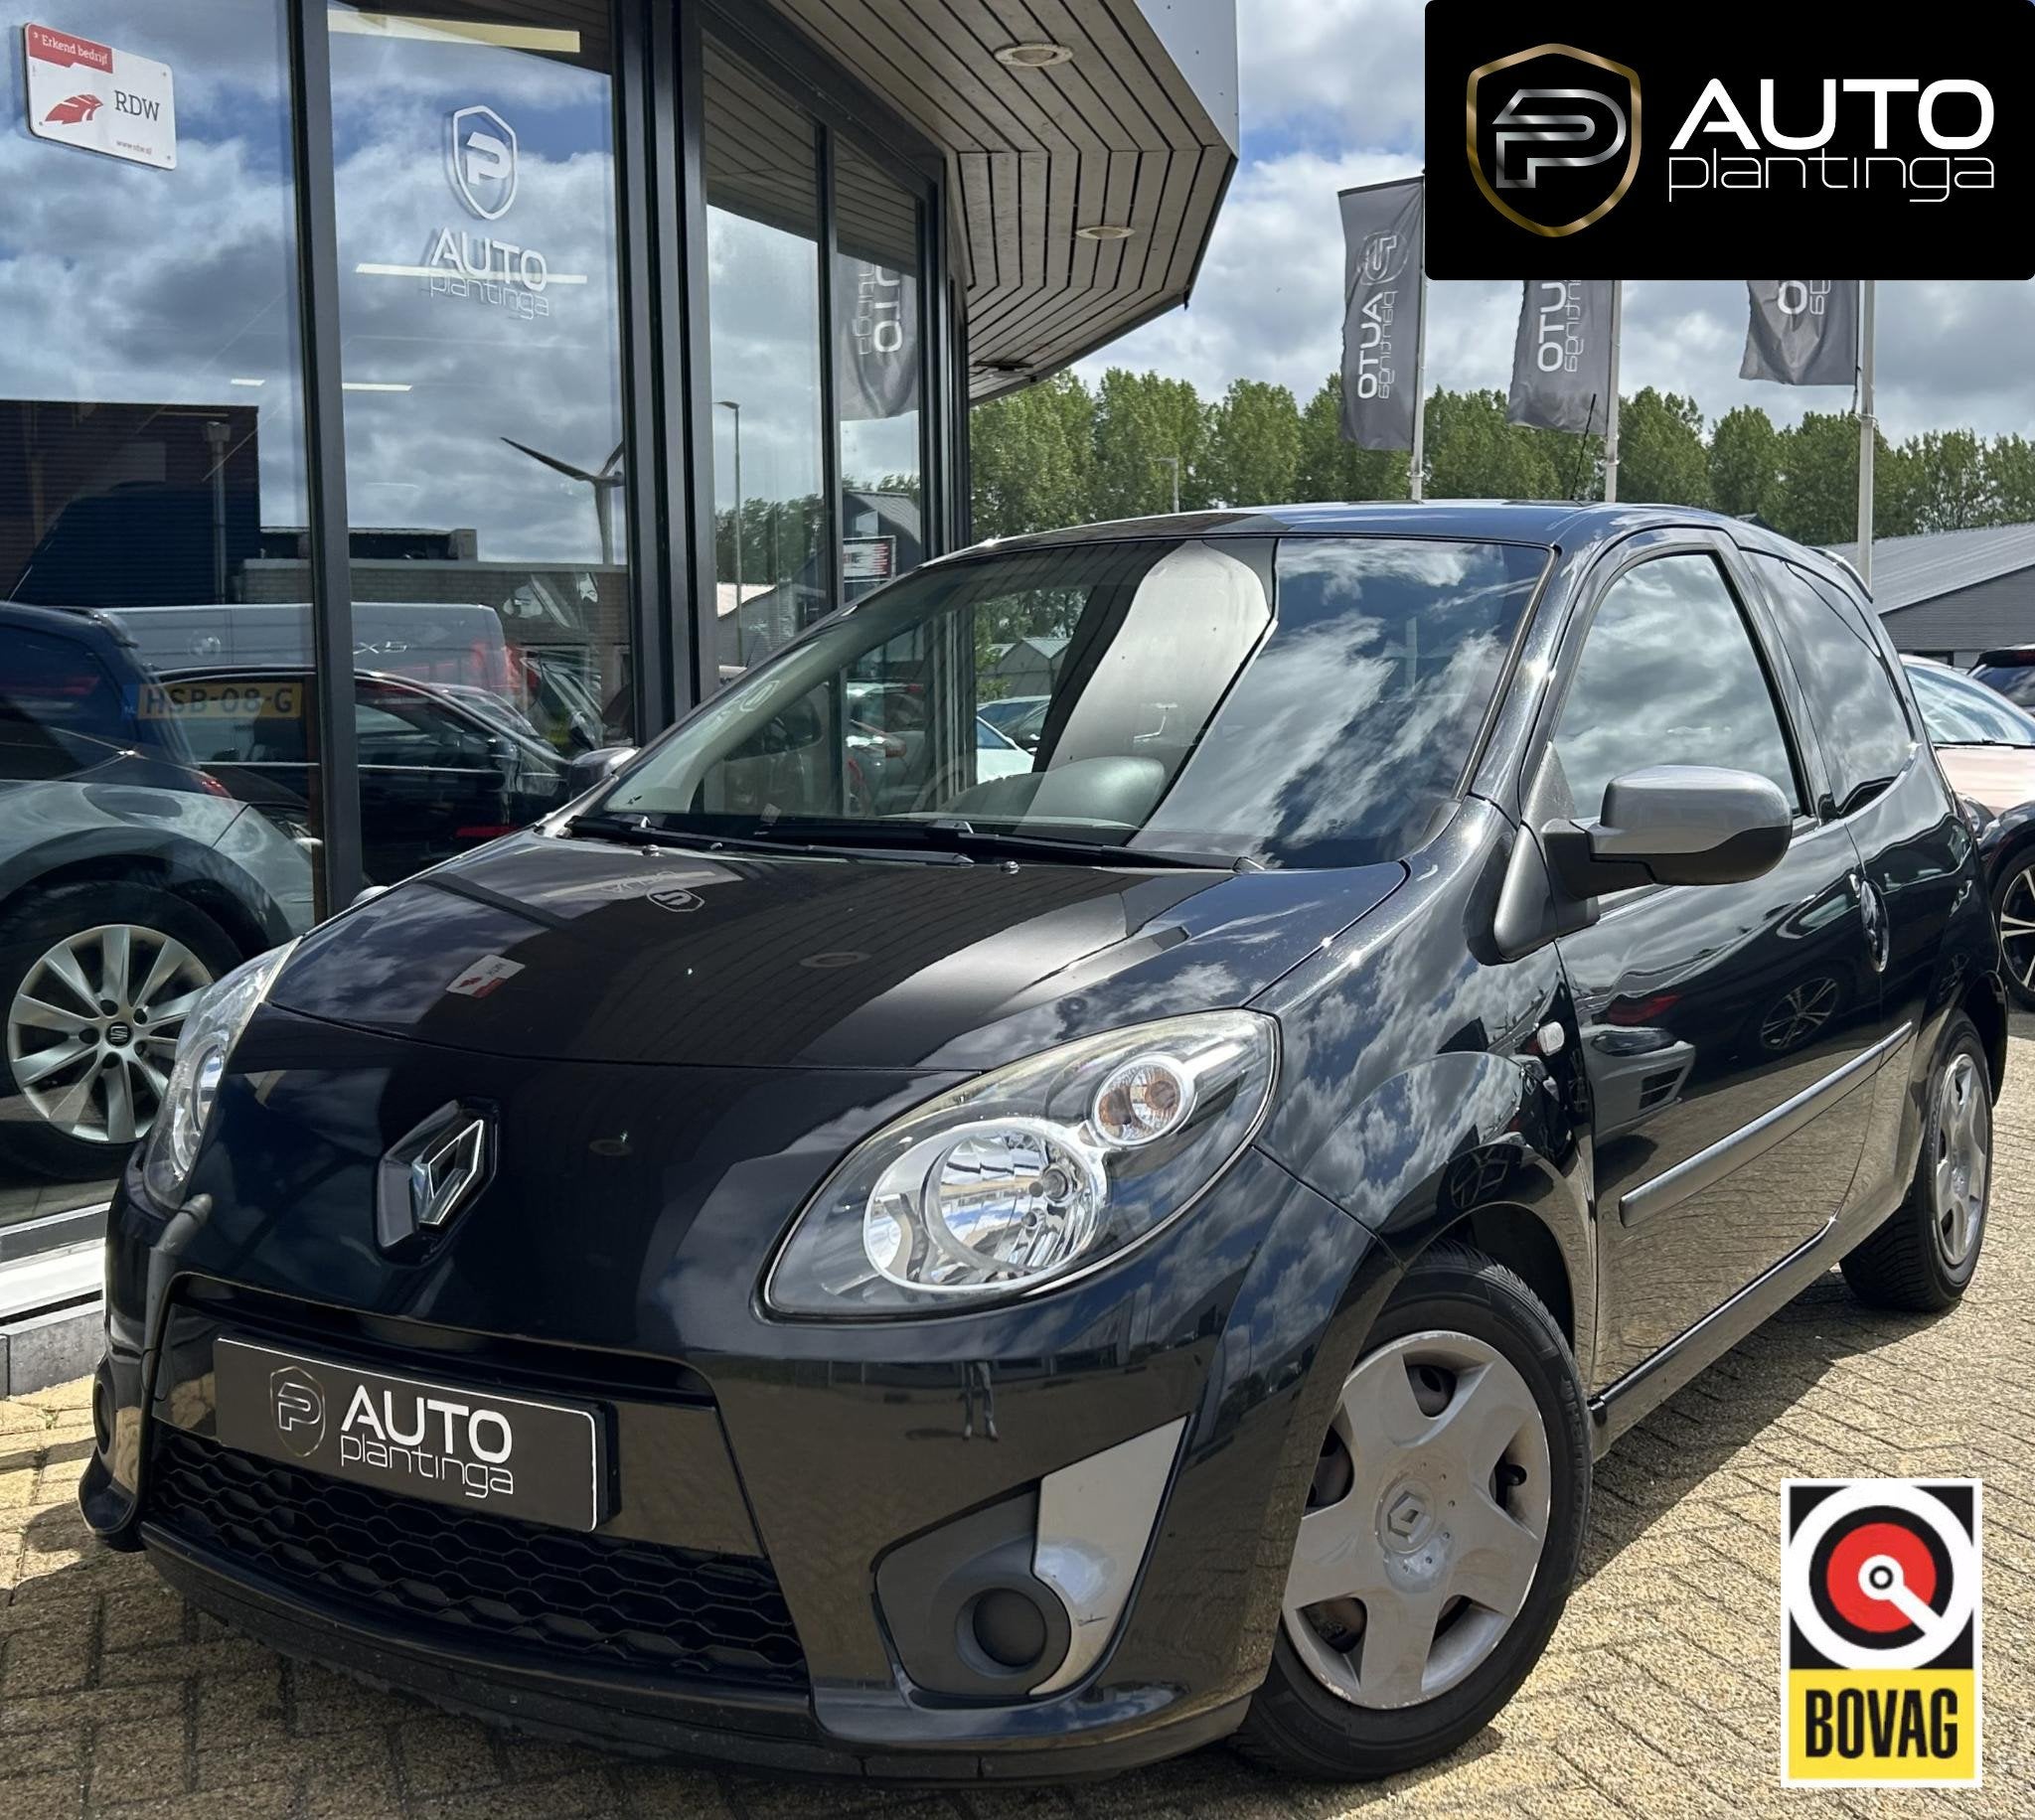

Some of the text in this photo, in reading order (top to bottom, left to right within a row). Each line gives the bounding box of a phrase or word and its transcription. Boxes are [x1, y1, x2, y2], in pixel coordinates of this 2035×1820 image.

[42, 34, 108, 66] Erkend bedrijf
[114, 89, 160, 122] RDW
[430, 226, 548, 292] AUTO
[429, 275, 549, 320] plantinga
[145, 686, 294, 713] HSB-08-G
[341, 1384, 513, 1464] AUTO
[340, 1433, 514, 1499] plantinga
